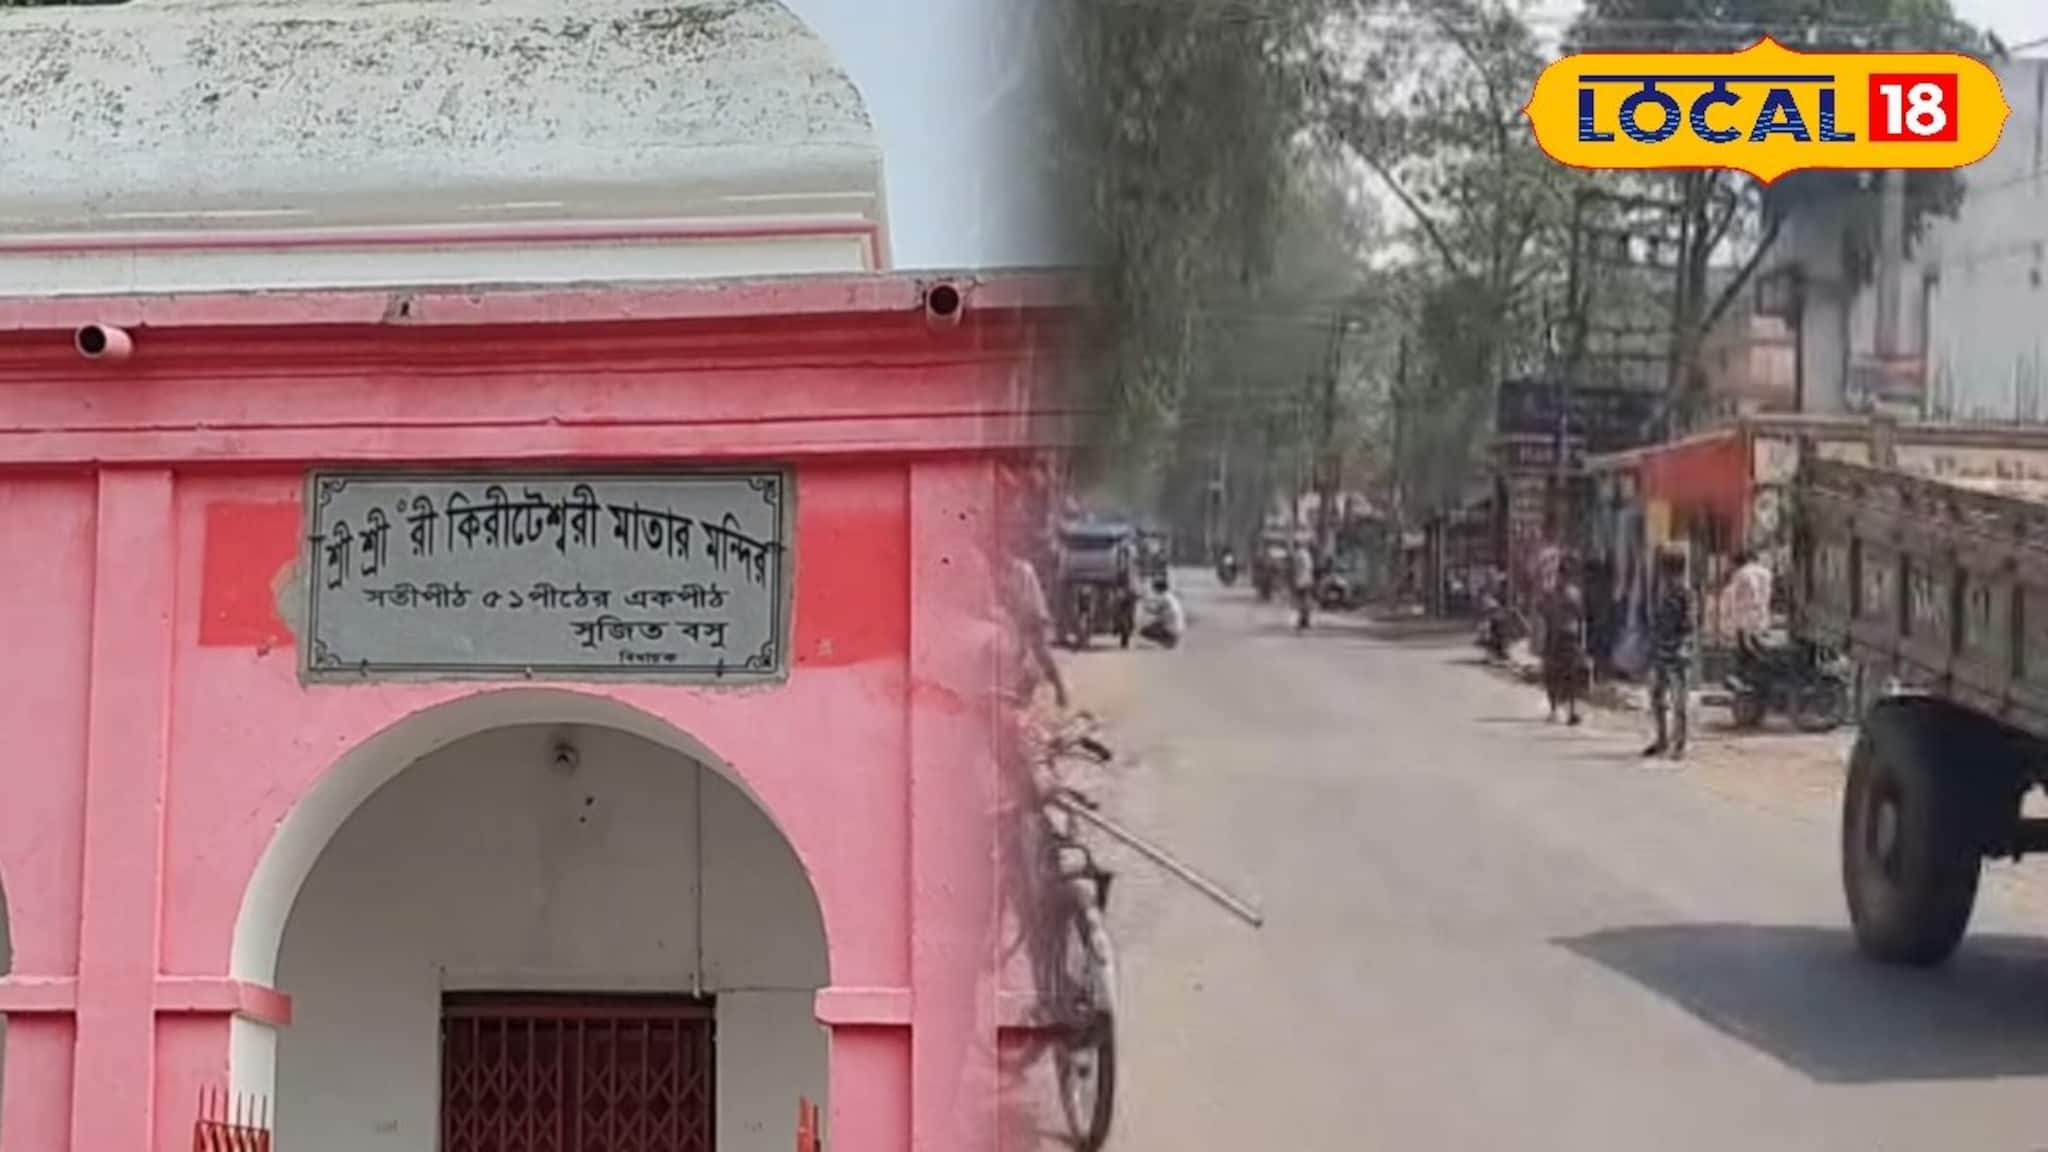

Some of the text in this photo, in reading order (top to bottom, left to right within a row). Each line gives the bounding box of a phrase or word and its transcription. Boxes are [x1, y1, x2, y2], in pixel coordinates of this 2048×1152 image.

[325, 520, 353, 590] শ্রী
[359, 507, 391, 576] শ্রী
[607, 501, 693, 560] মাতার
[701, 512, 773, 589] মন্দির
[362, 581, 473, 609] সতীপীঠ
[570, 614, 729, 648] সুজিত বসু
